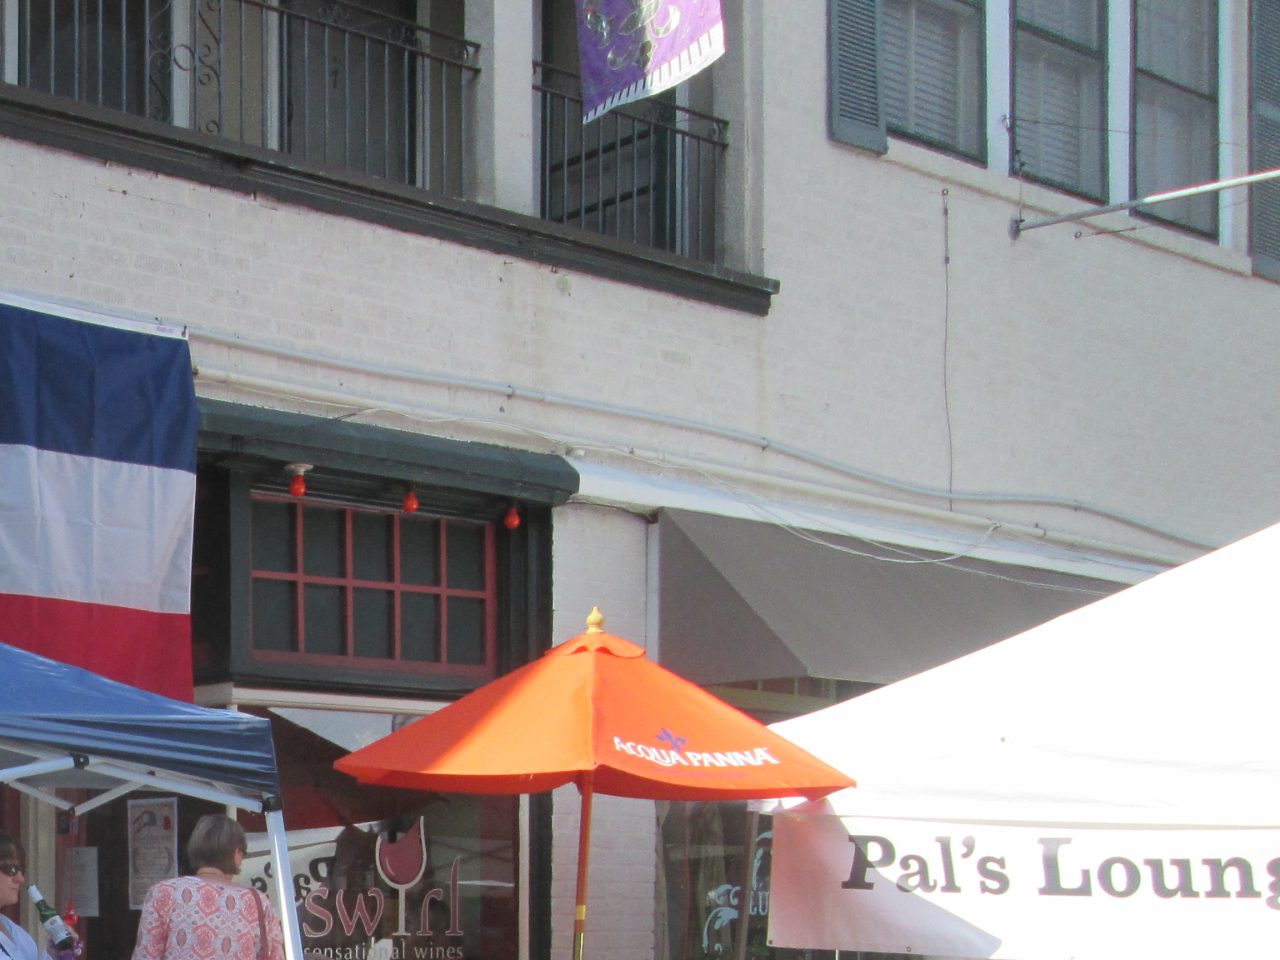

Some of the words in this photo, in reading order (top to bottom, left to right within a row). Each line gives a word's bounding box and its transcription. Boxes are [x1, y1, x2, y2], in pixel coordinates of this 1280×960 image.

[612, 735, 690, 767] ACQUA
[686, 746, 780, 767] PANNA
[303, 816, 464, 938] swirl
[841, 834, 1011, 896] Pal's
[303, 938, 406, 960] sensatial
[415, 943, 464, 960] wines
